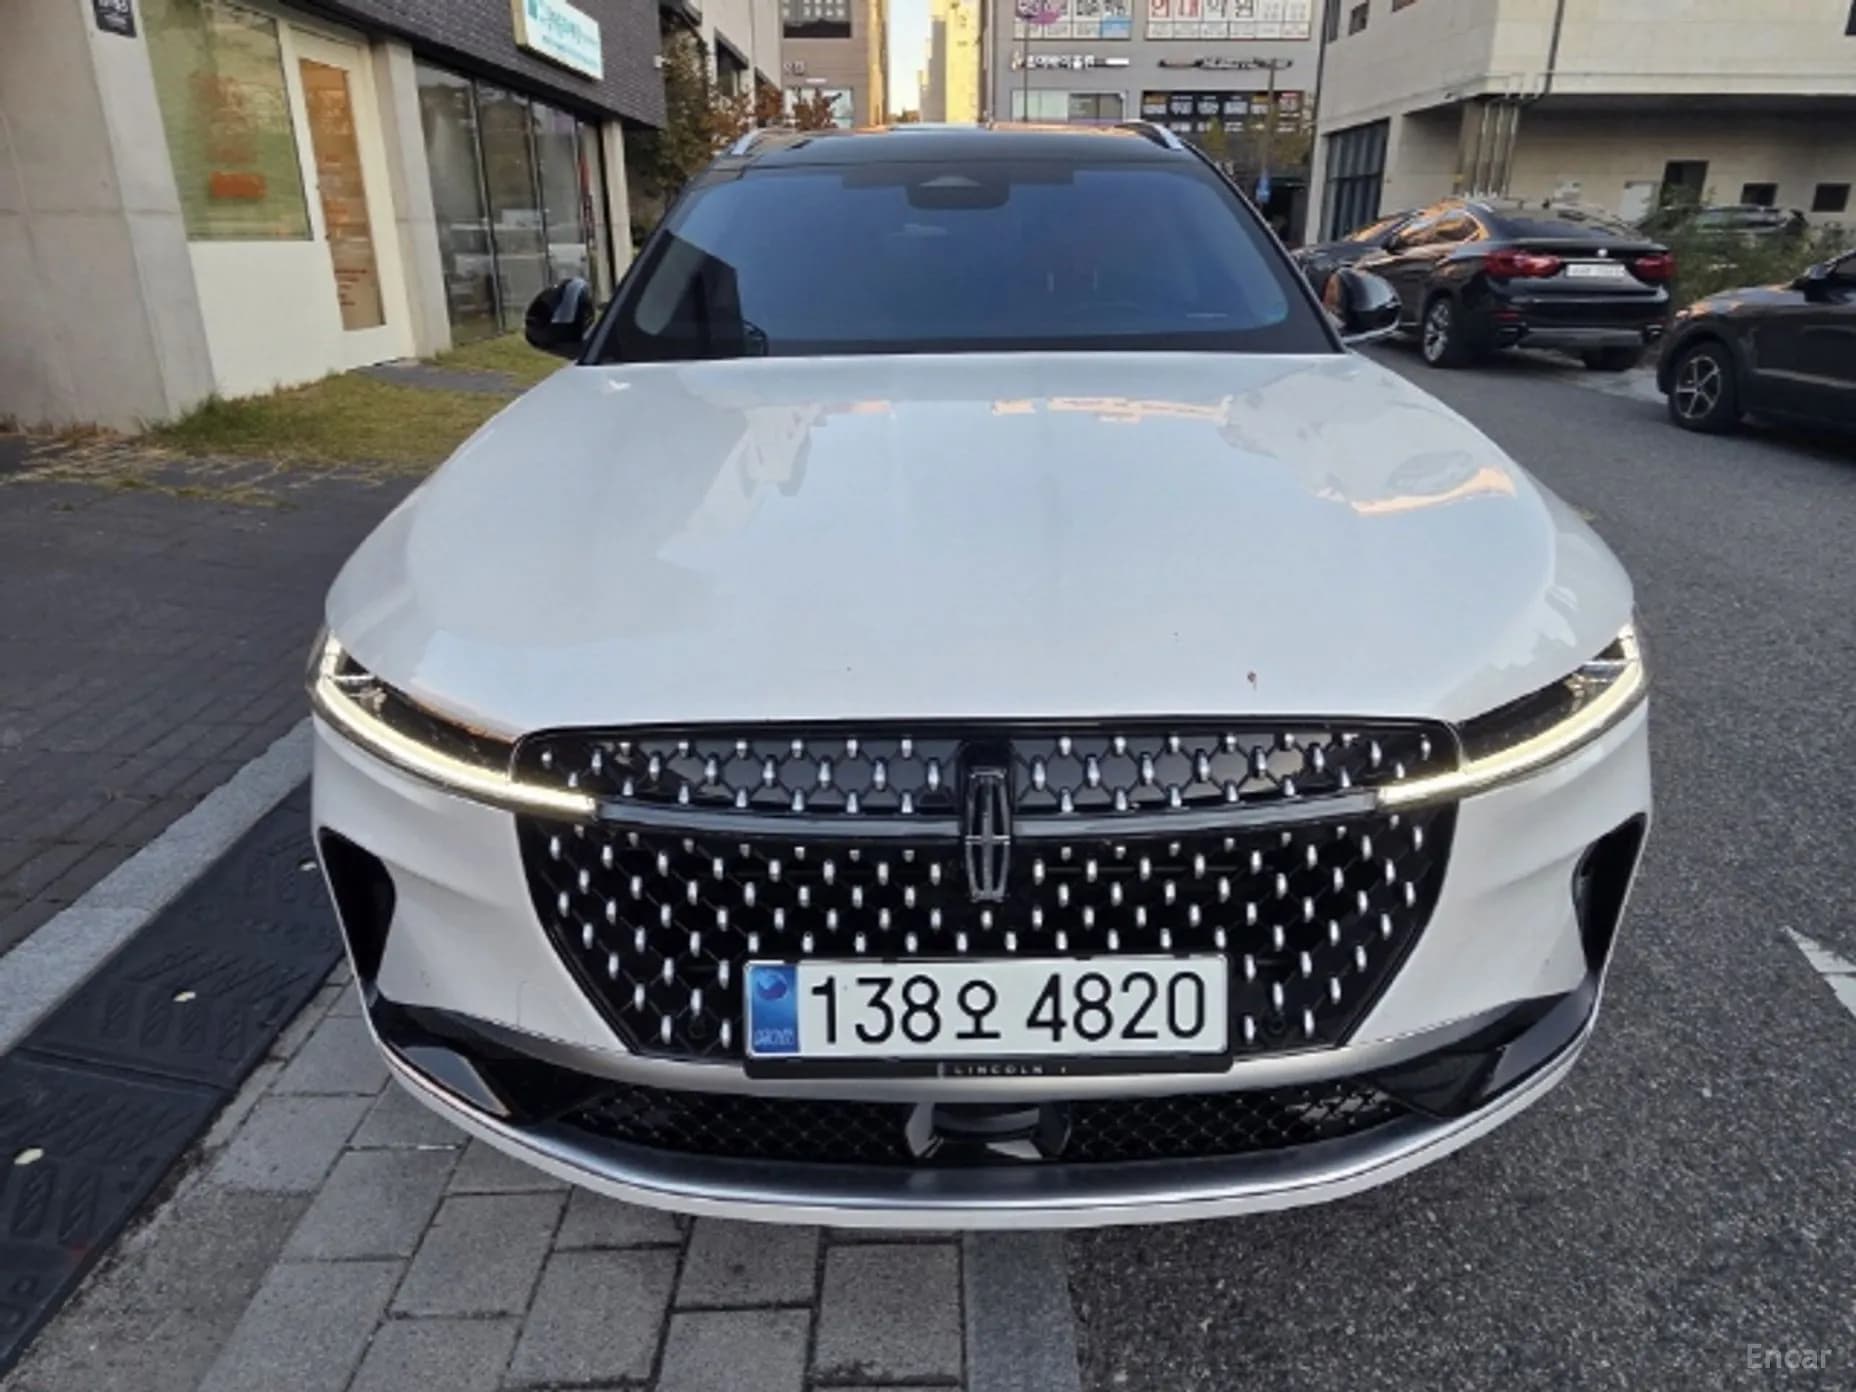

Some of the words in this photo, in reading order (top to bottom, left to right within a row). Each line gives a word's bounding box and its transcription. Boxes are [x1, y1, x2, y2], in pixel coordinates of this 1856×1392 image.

[811, 974, 1001, 1044] 138오
[1026, 971, 1206, 1042] 4820
[953, 1064, 1043, 1075] LINCOLN
